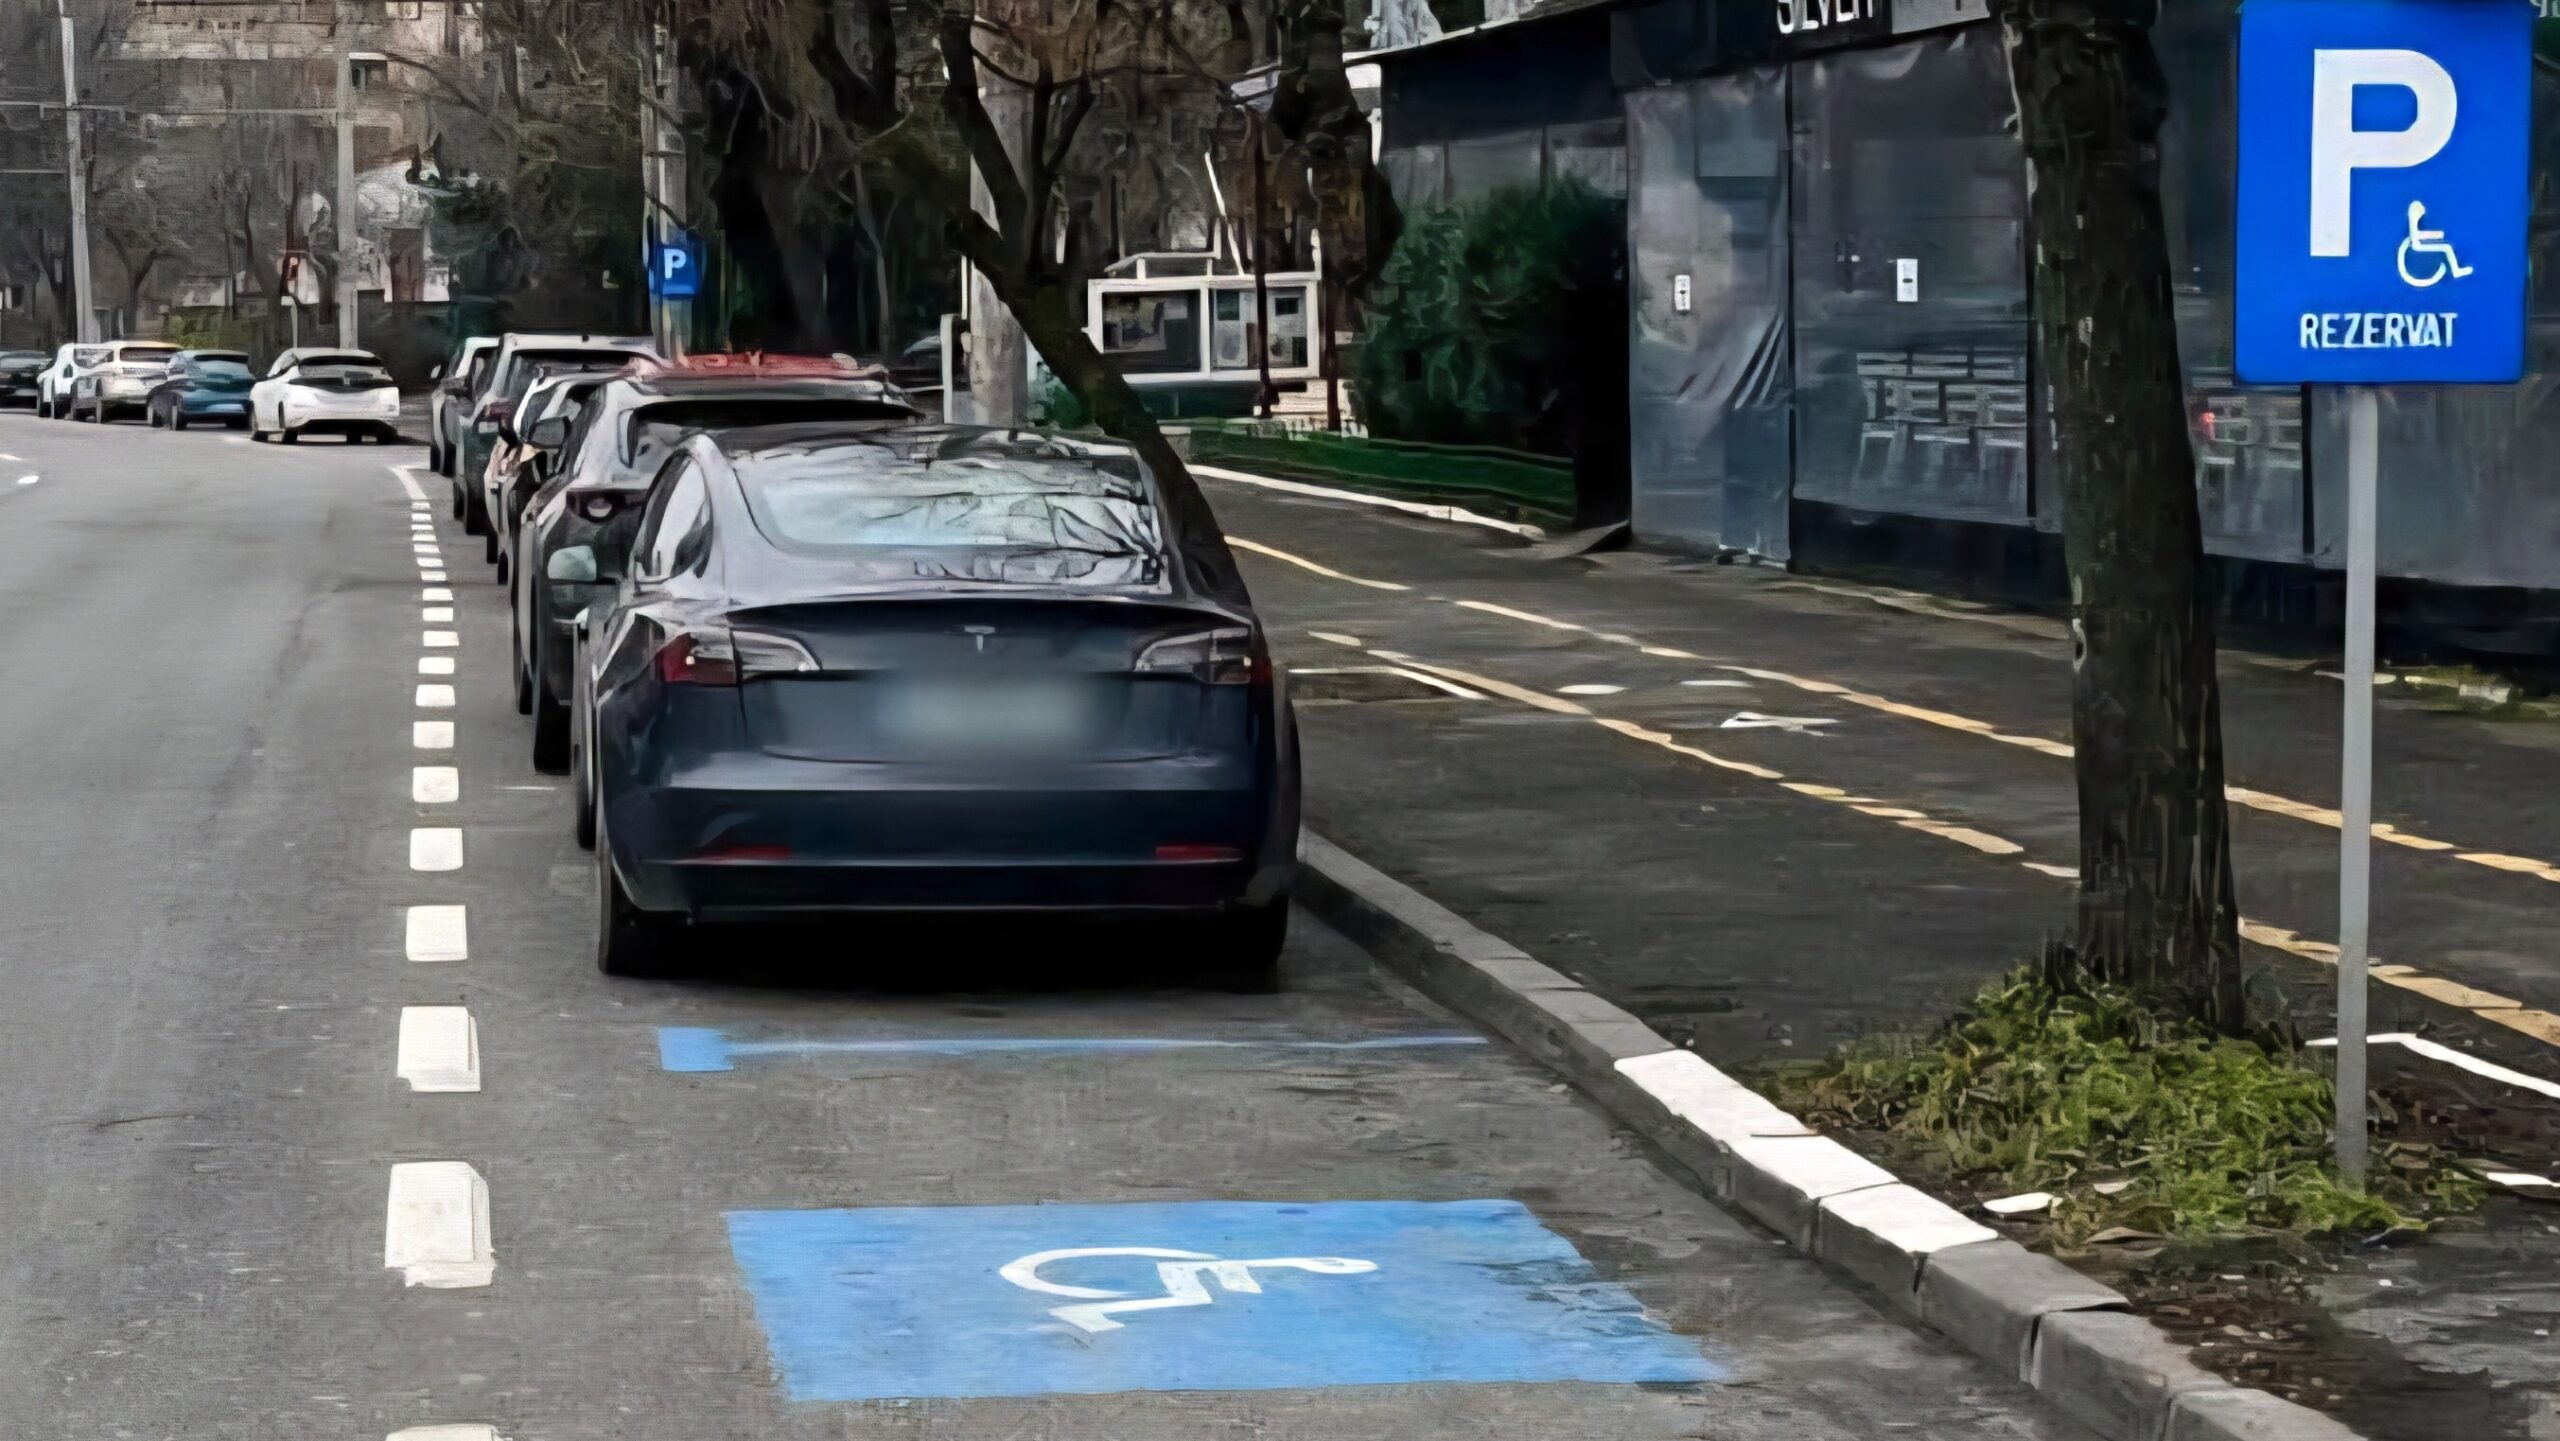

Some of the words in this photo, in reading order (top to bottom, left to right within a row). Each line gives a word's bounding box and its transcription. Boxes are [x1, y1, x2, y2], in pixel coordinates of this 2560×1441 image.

[2310, 48, 2457, 257] P
[663, 248, 686, 280] P
[2300, 312, 2458, 348] REZERVAT
